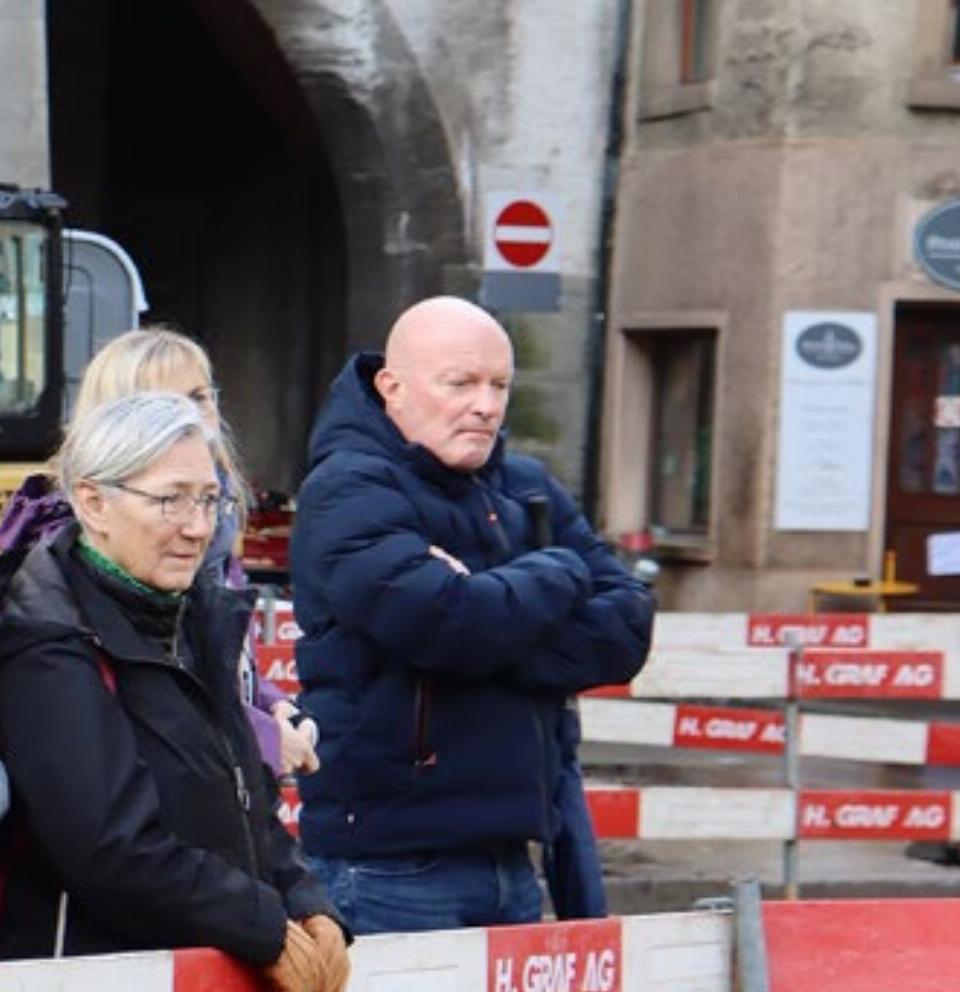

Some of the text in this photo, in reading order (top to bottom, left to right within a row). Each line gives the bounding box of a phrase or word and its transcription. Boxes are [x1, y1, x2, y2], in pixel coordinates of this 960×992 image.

[894, 664, 934, 687] AG
[802, 804, 945, 829] H. GRAF AG
[581, 949, 615, 992] AG
